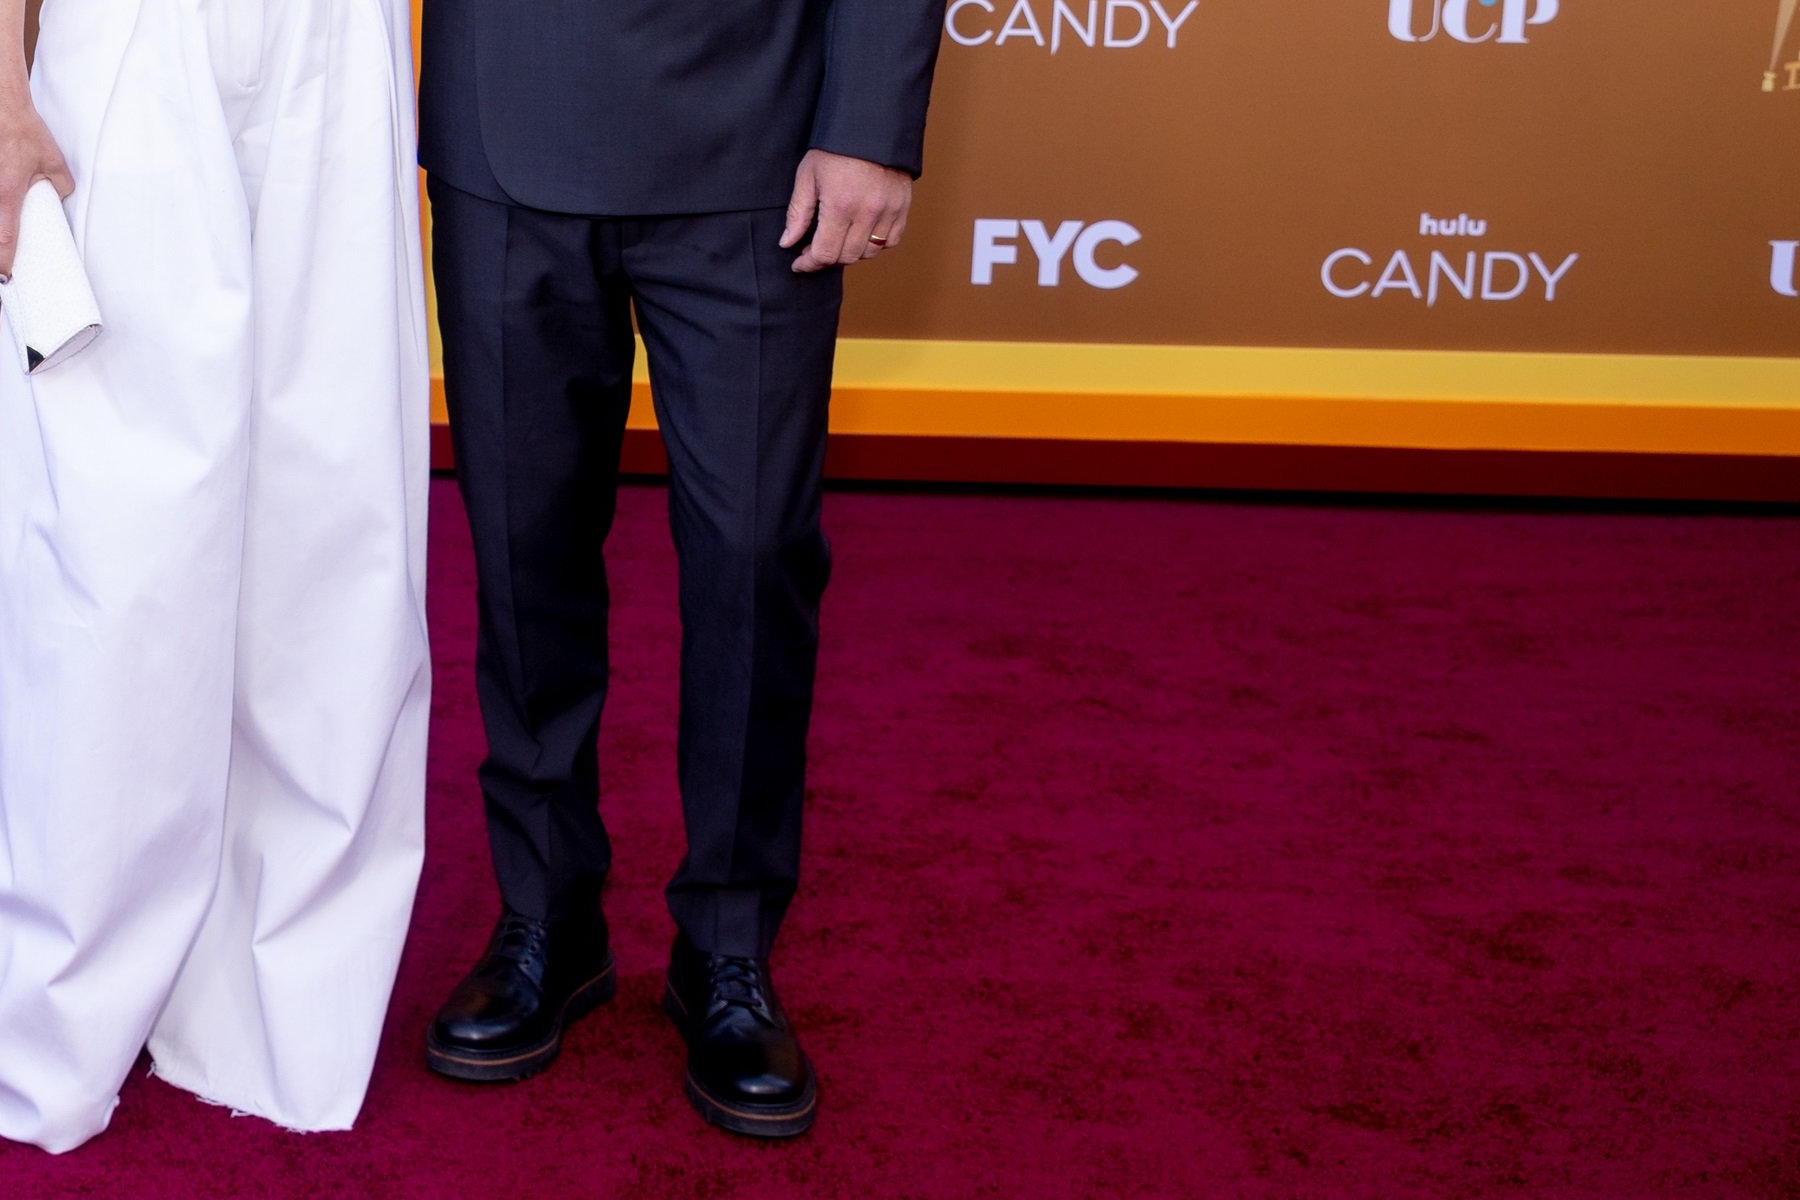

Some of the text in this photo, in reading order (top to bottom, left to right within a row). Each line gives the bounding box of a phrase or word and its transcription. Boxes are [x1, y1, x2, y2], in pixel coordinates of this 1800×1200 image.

[971, 218, 1142, 290] FYC
[1419, 213, 1486, 237] hulu
[1320, 247, 1578, 308] CANDY
